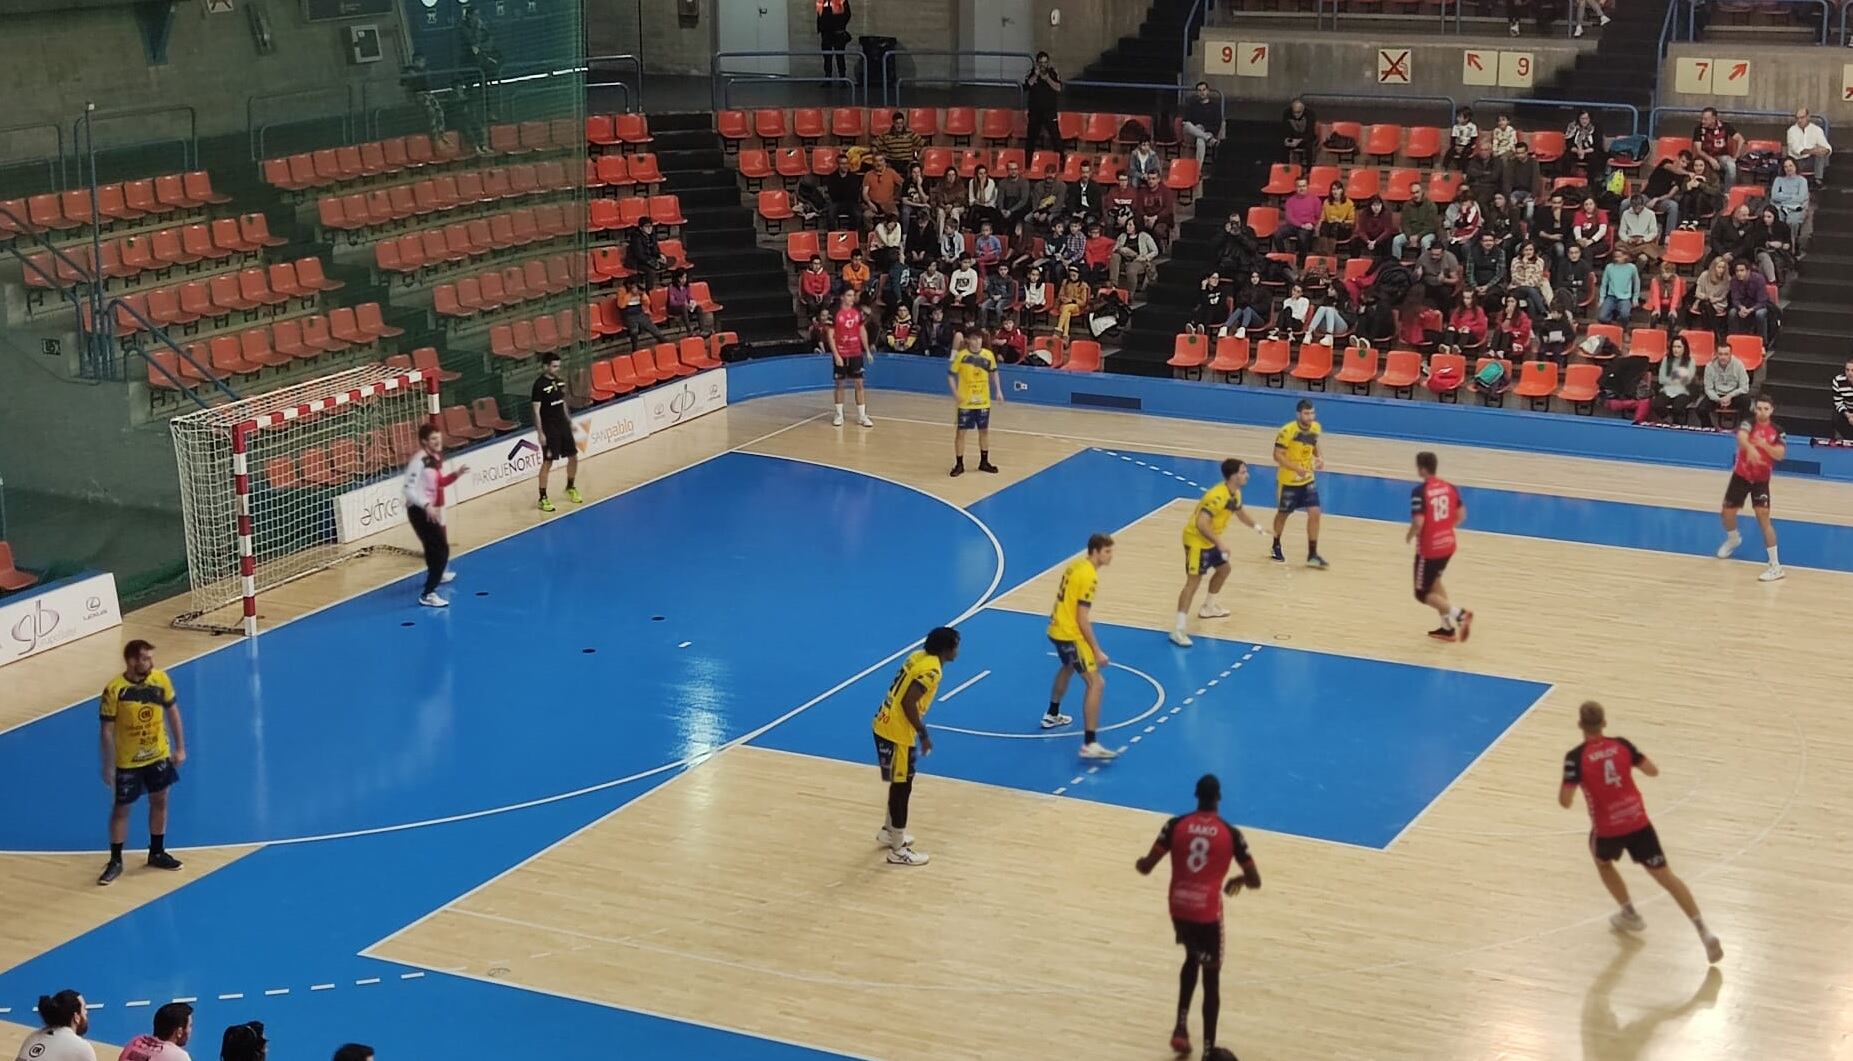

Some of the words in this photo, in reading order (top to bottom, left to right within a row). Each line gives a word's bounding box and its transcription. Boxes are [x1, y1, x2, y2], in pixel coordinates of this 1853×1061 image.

[1222, 46, 1232, 63] 9
[1517, 57, 1530, 76] 9
[1696, 62, 1709, 81] 7
[1430, 495, 1449, 522] 18
[1604, 759, 1622, 788] 4
[1186, 836, 1210, 873] 8
